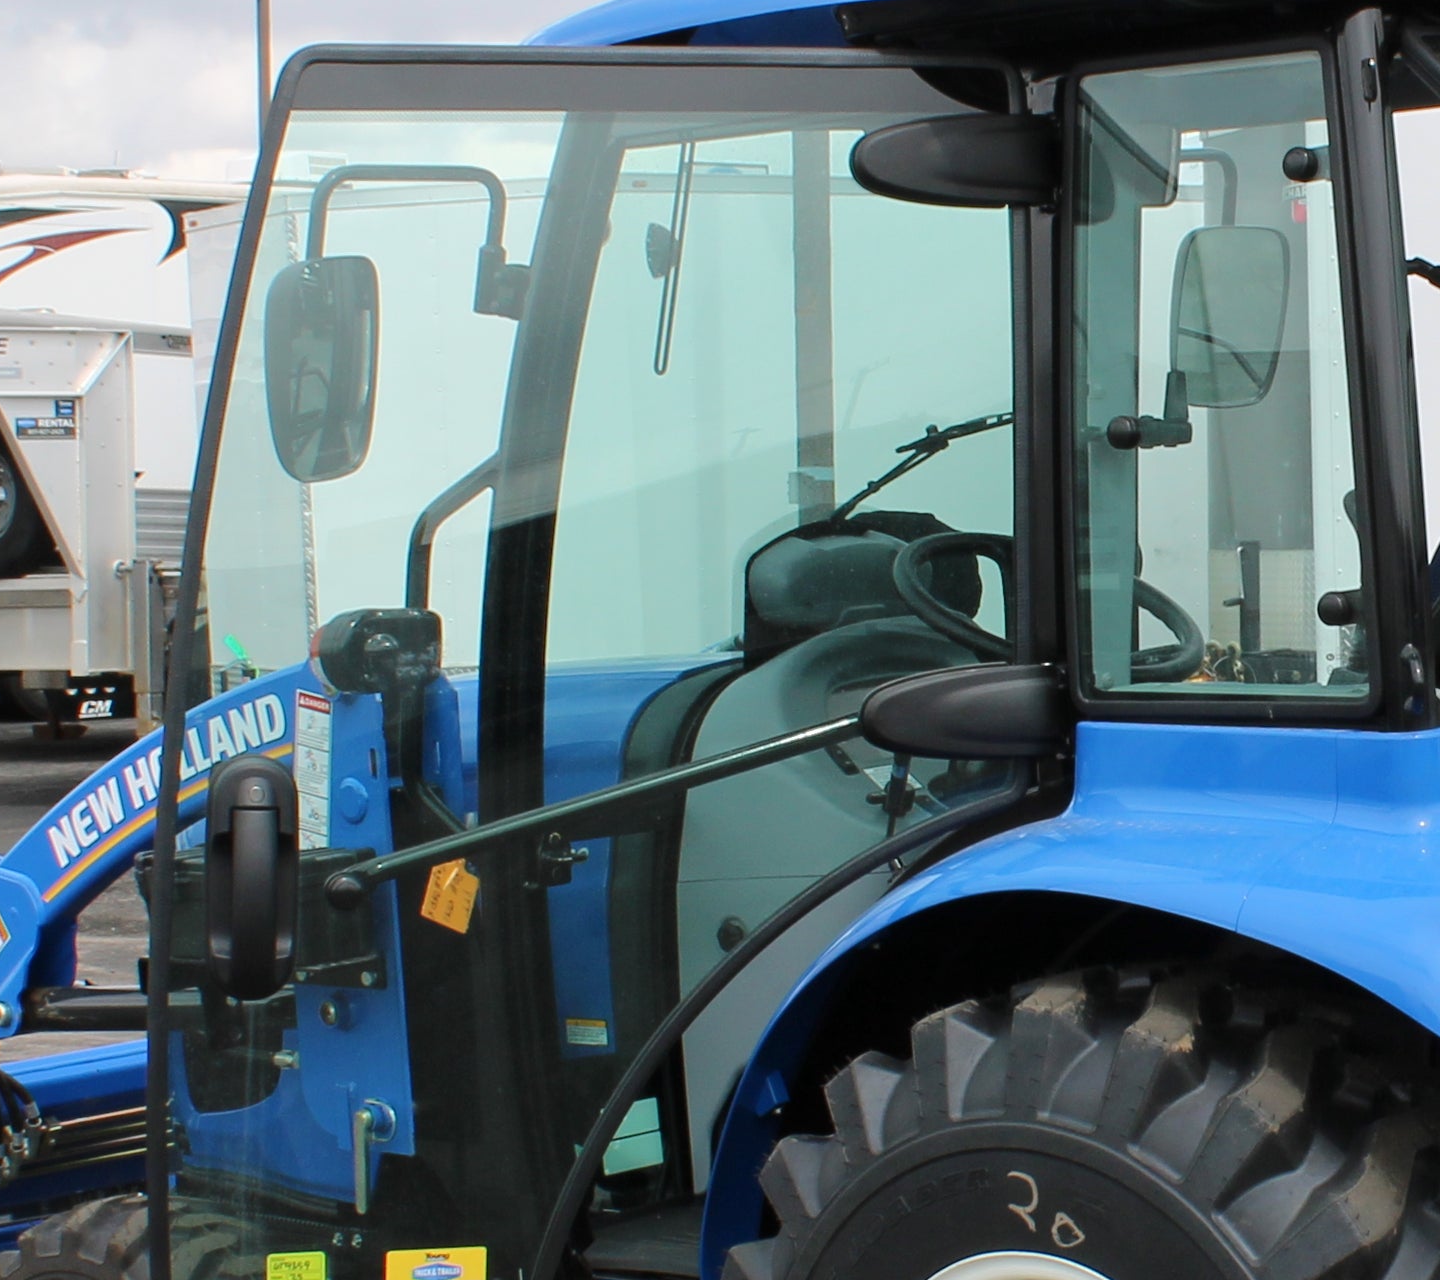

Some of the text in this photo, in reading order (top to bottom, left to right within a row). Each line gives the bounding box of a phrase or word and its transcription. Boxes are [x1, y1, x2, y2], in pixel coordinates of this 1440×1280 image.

[37, 418, 74, 428] RENTAL
[80, 699, 113, 714] CM
[47, 775, 126, 869] NEW
